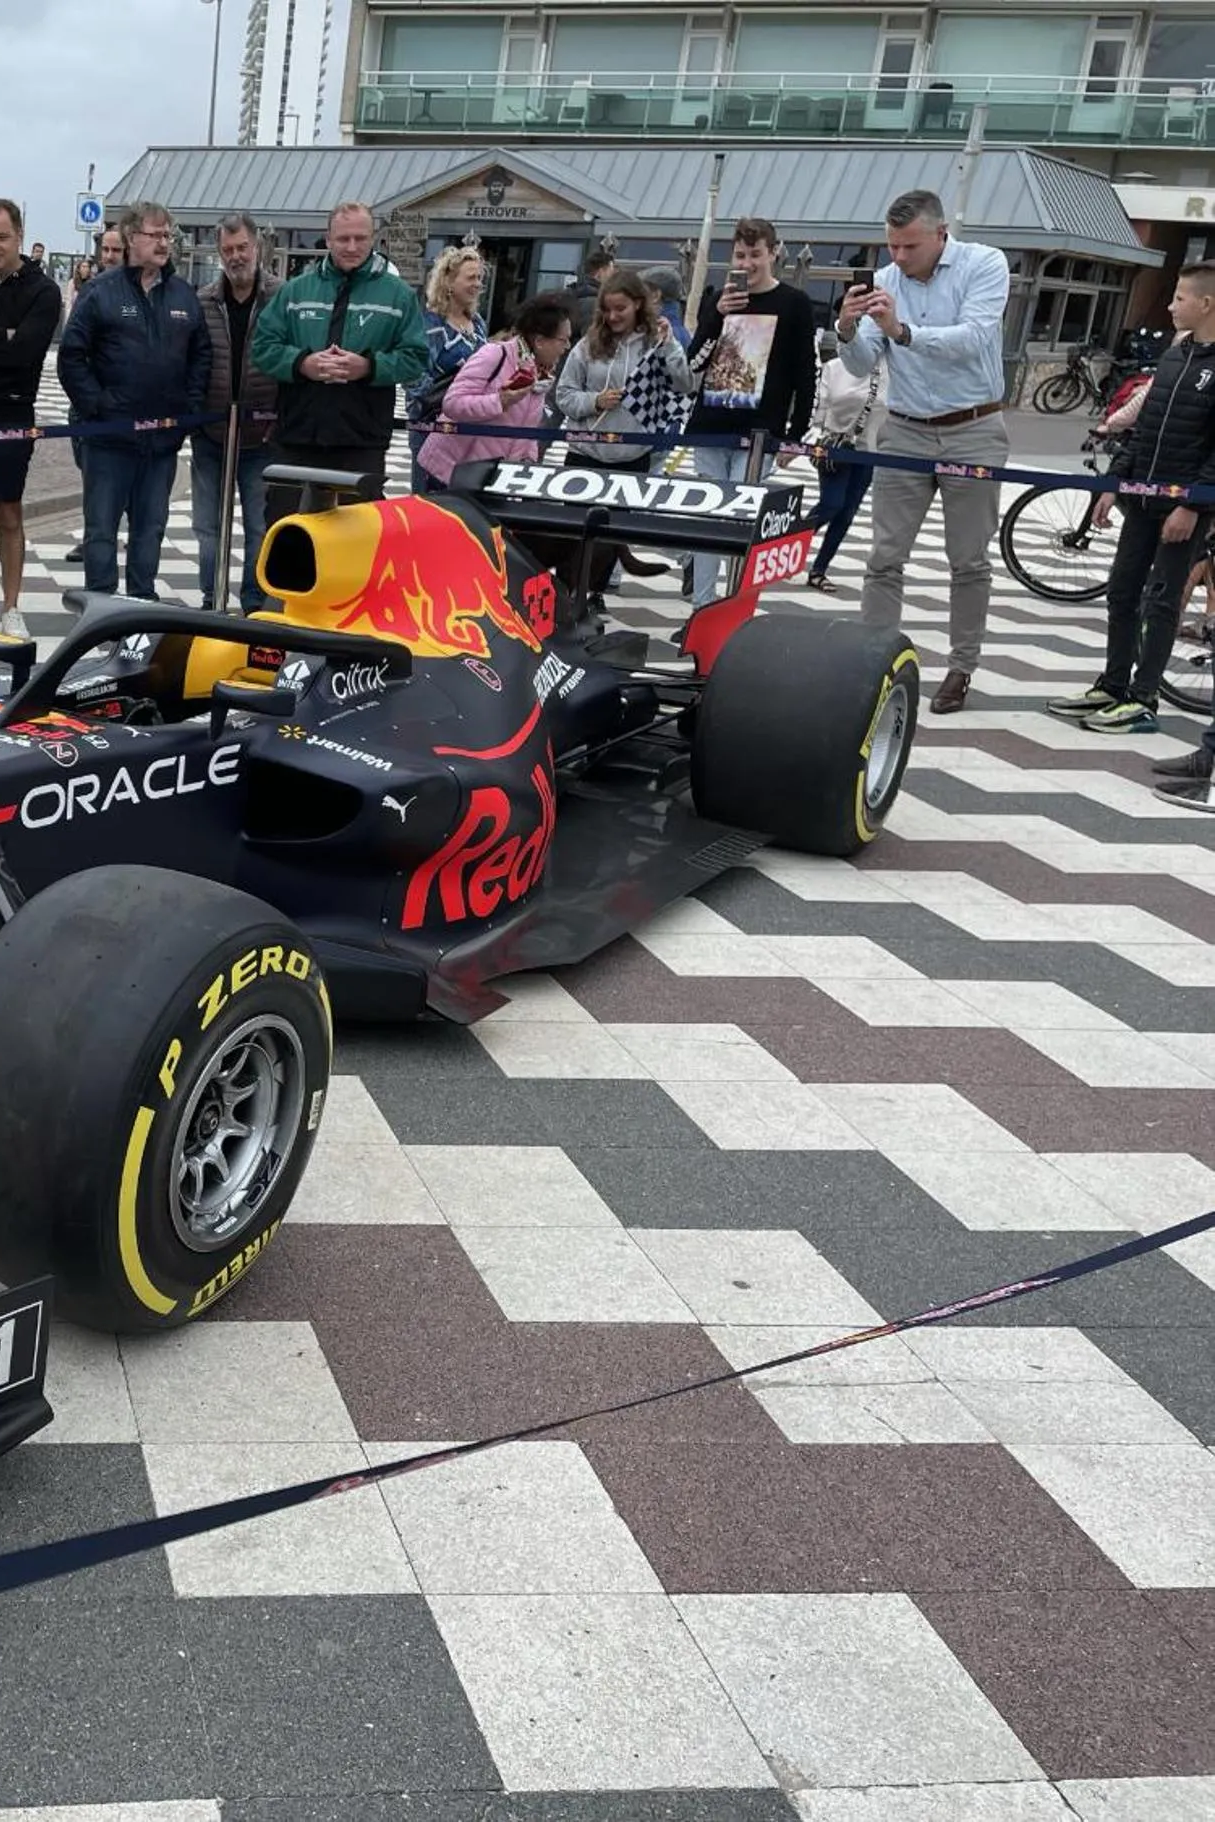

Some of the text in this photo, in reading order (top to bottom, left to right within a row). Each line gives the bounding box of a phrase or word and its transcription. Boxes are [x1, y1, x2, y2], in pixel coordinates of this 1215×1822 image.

[466, 207, 527, 218] ZEEROVER
[484, 464, 767, 518] HONDA
[752, 540, 803, 585] ESSO
[306, 735, 393, 771] Walmart
[21, 744, 241, 829] ORACLE
[401, 764, 556, 930] Red
[158, 945, 311, 1100] P ZERO
